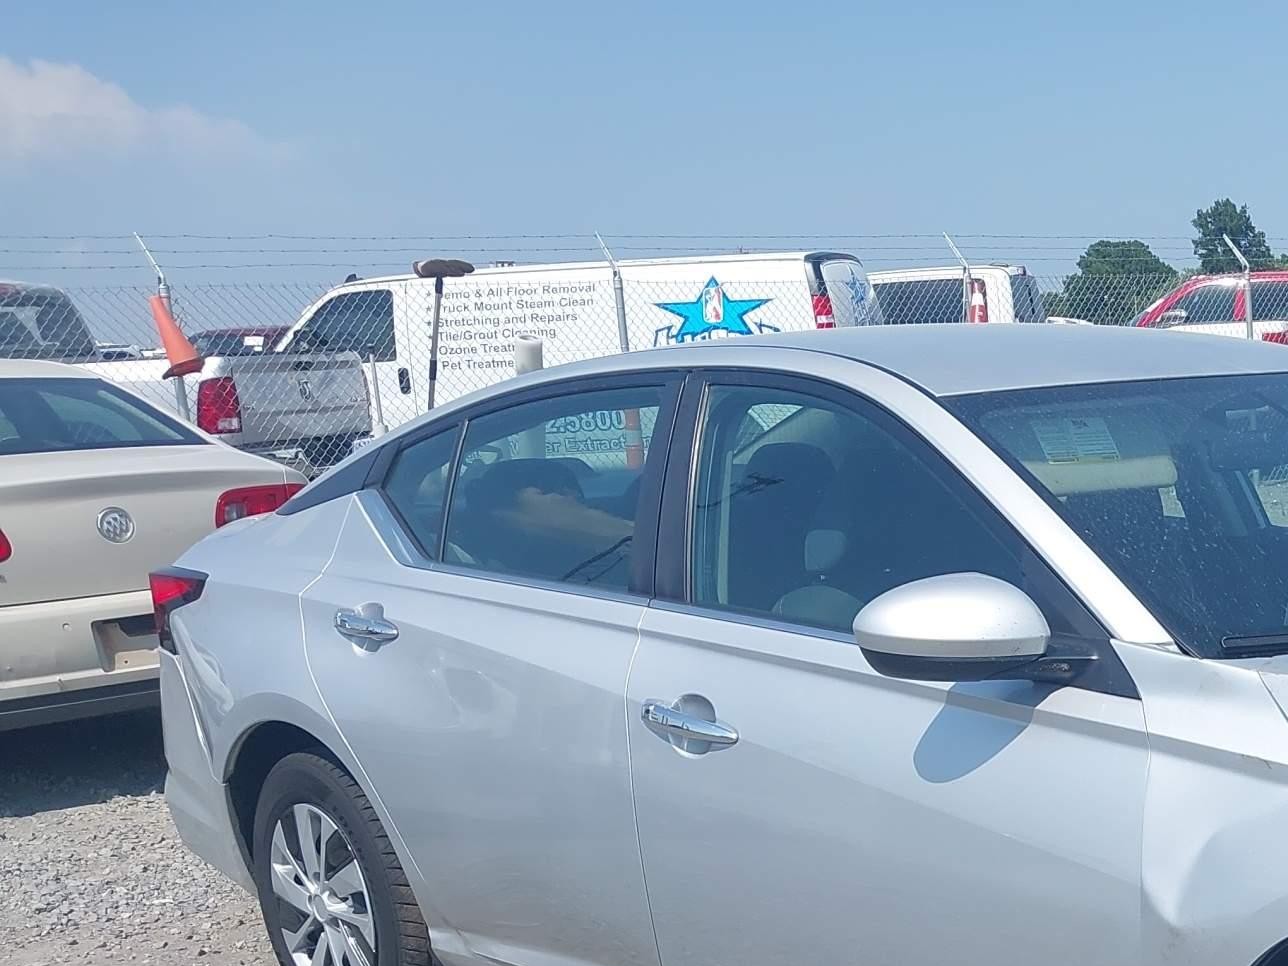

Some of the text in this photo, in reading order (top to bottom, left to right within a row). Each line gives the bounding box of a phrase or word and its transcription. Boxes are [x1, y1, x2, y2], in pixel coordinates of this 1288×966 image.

[474, 288, 483, 298] &
[487, 287, 502, 297] All
[507, 286, 538, 296] Floor
[542, 283, 595, 295] Removal
[474, 301, 512, 312] Mount
[516, 299, 555, 310] Steam
[559, 297, 594, 307] Clean
[438, 311, 578, 328] Stretching and Repairs
[439, 345, 477, 355] Ozone
[442, 359, 462, 370] Pet
